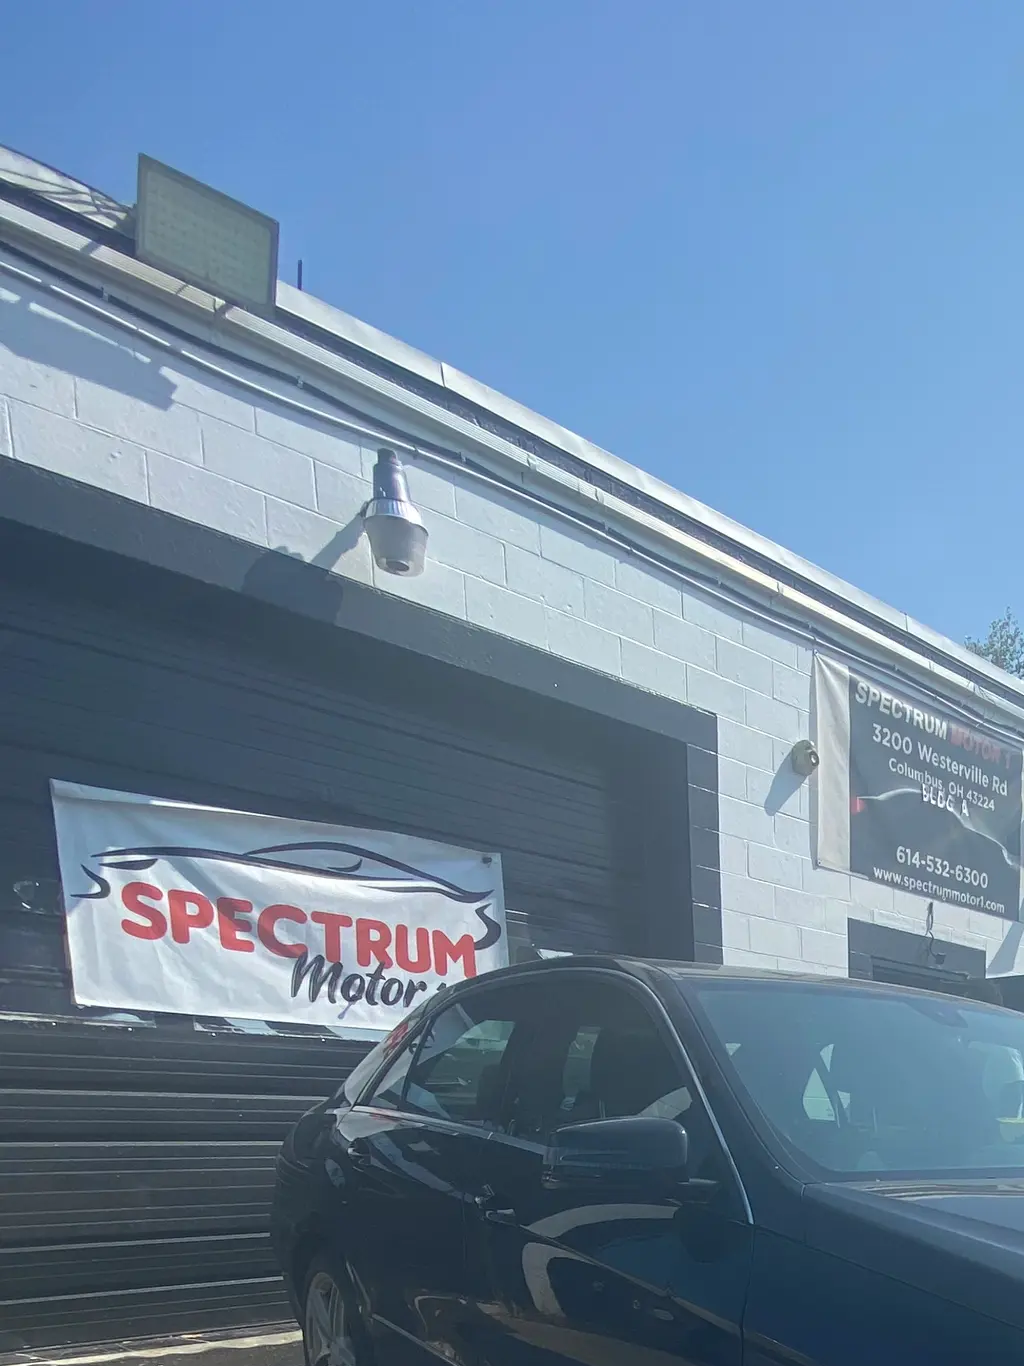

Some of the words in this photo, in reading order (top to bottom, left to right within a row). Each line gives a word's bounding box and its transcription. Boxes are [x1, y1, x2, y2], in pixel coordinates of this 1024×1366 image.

[855, 682, 948, 740] SPECTRUM
[872, 723, 912, 753] 3200
[918, 741, 989, 787] Westerville
[992, 775, 1008, 796] Rd
[889, 758, 945, 793] Columbus,
[948, 782, 964, 799] OH
[966, 790, 995, 812] 43224
[922, 783, 954, 812] BLDG
[960, 799, 969, 817] A
[874, 867, 1005, 914] www.spectrummotor1.com
[896, 846, 988, 889] 614-532-6300
[121, 882, 476, 978] SPECTRUM
[290, 953, 427, 1008] Motor
